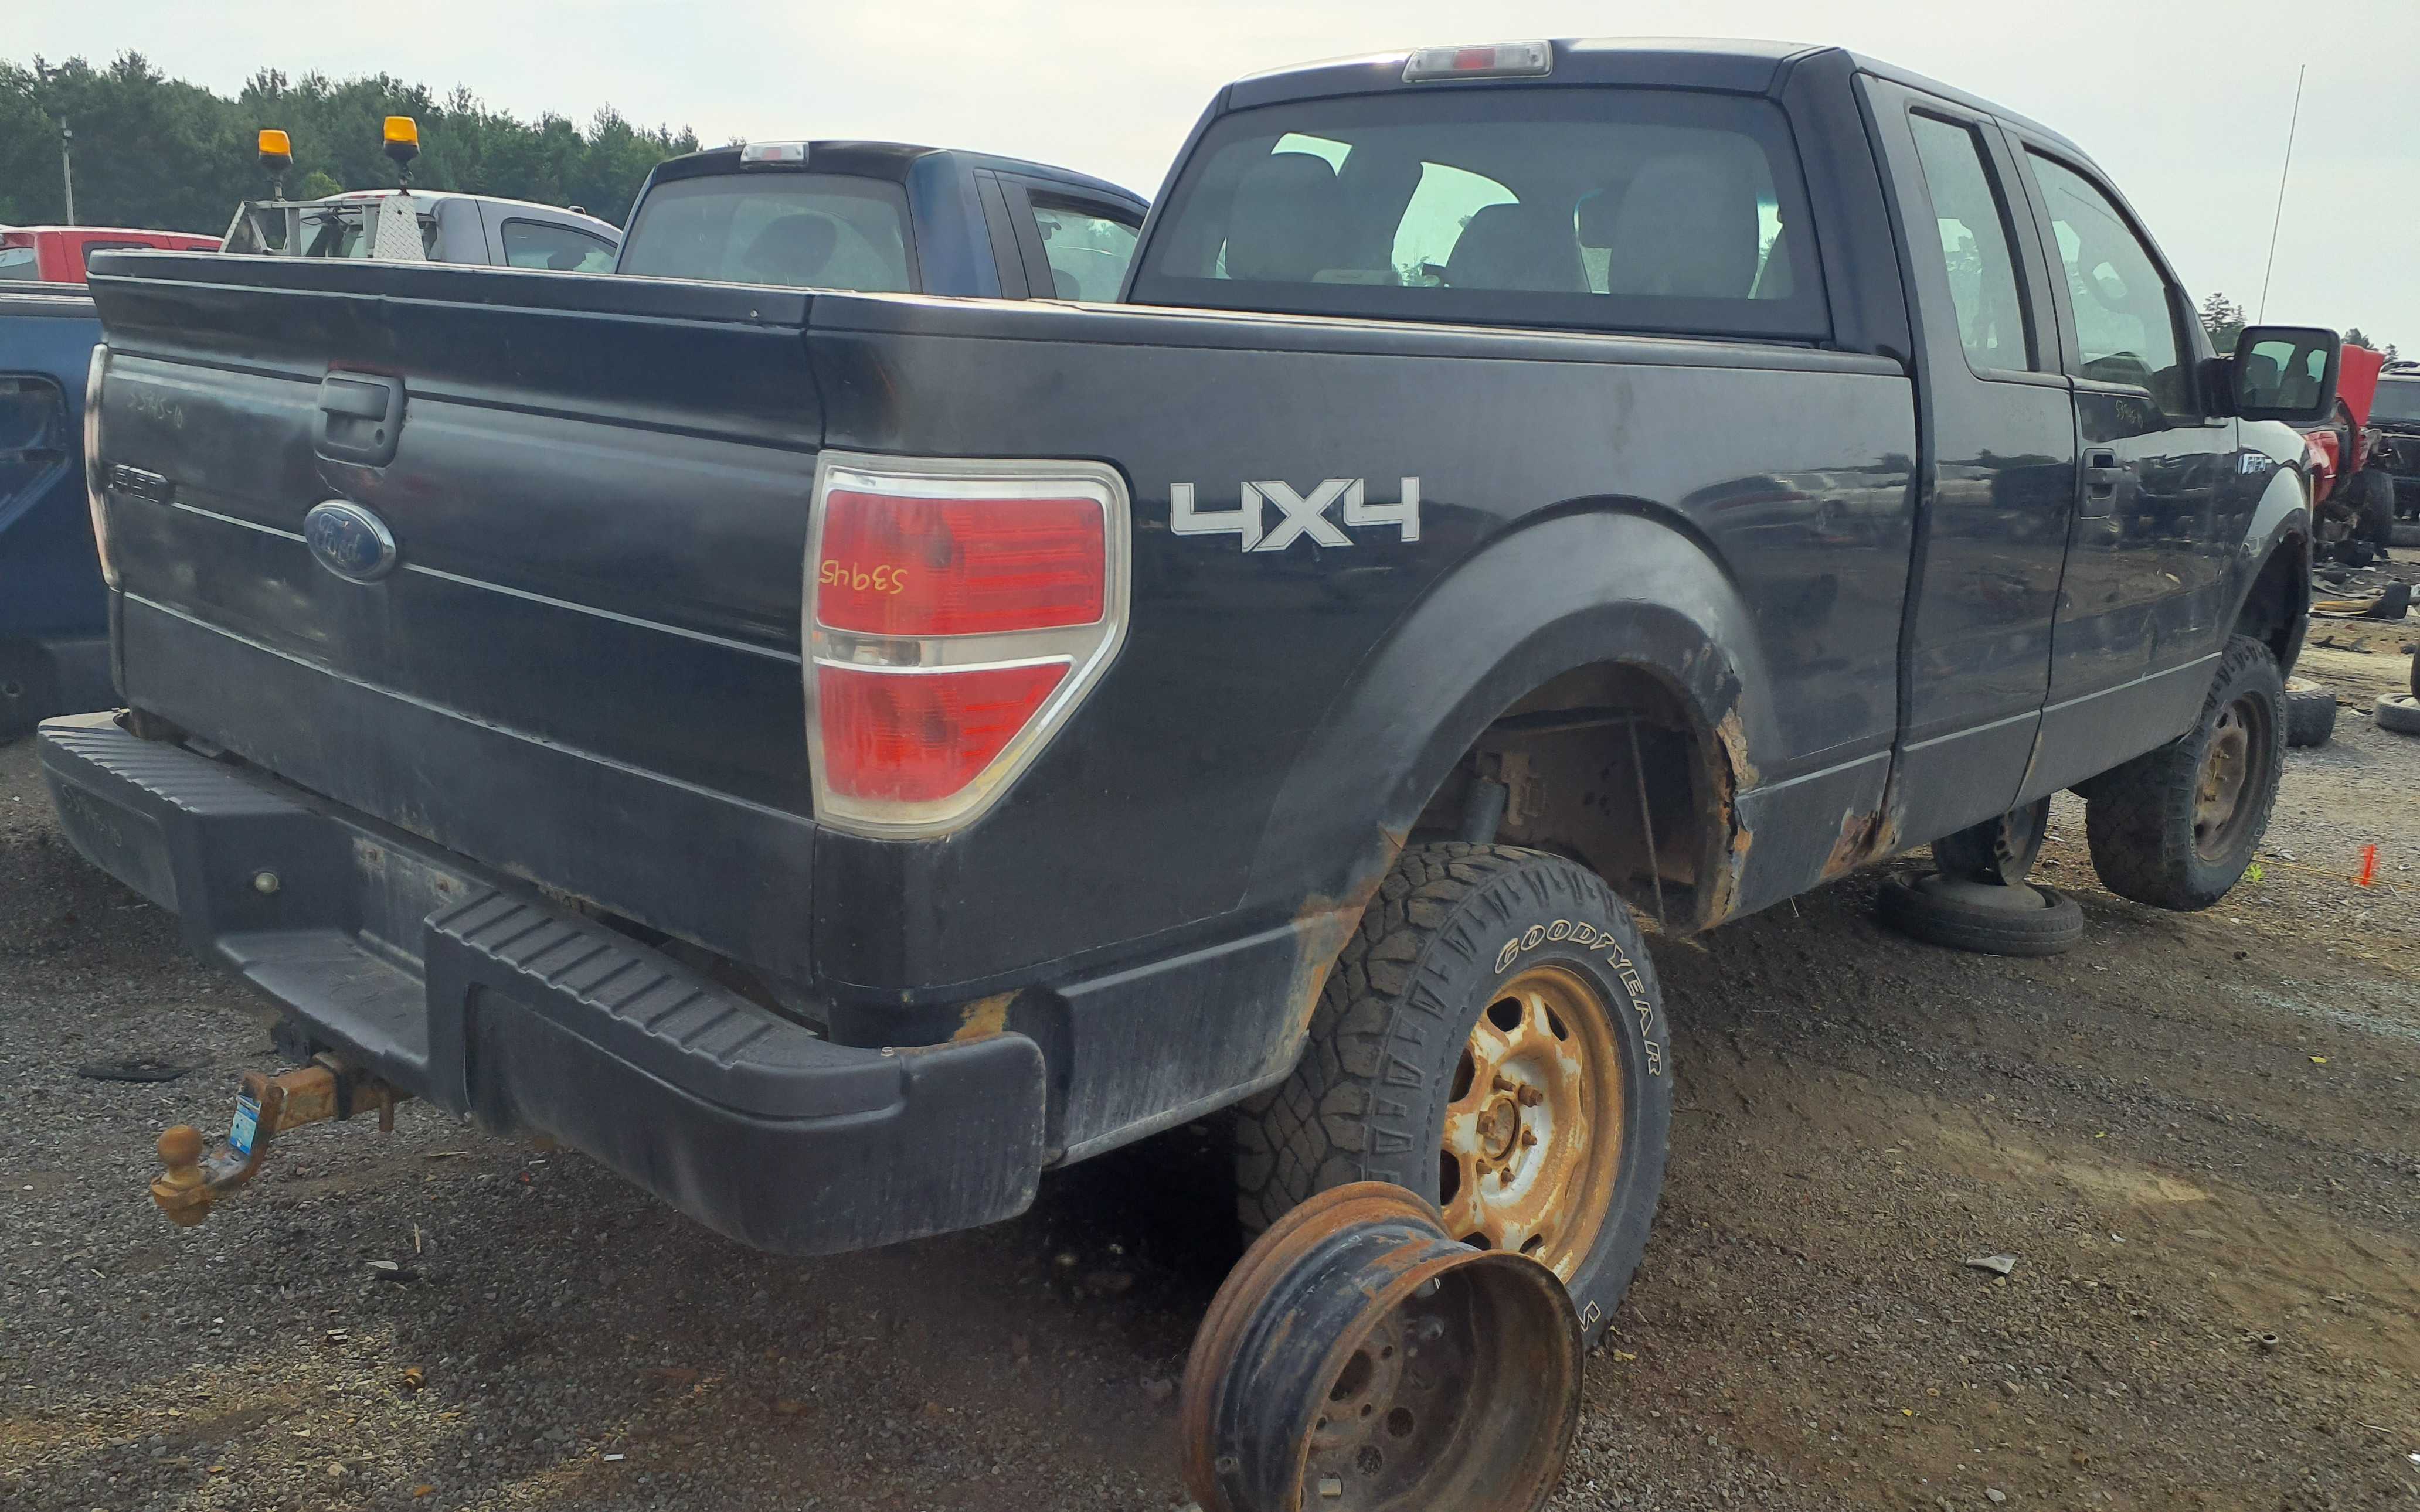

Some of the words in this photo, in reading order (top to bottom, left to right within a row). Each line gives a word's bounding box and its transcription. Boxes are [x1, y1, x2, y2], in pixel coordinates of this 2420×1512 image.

[1170, 476, 1420, 553] 4X4
[817, 559, 908, 595] 53945
[1495, 919, 1661, 1077] GOODYEAR
